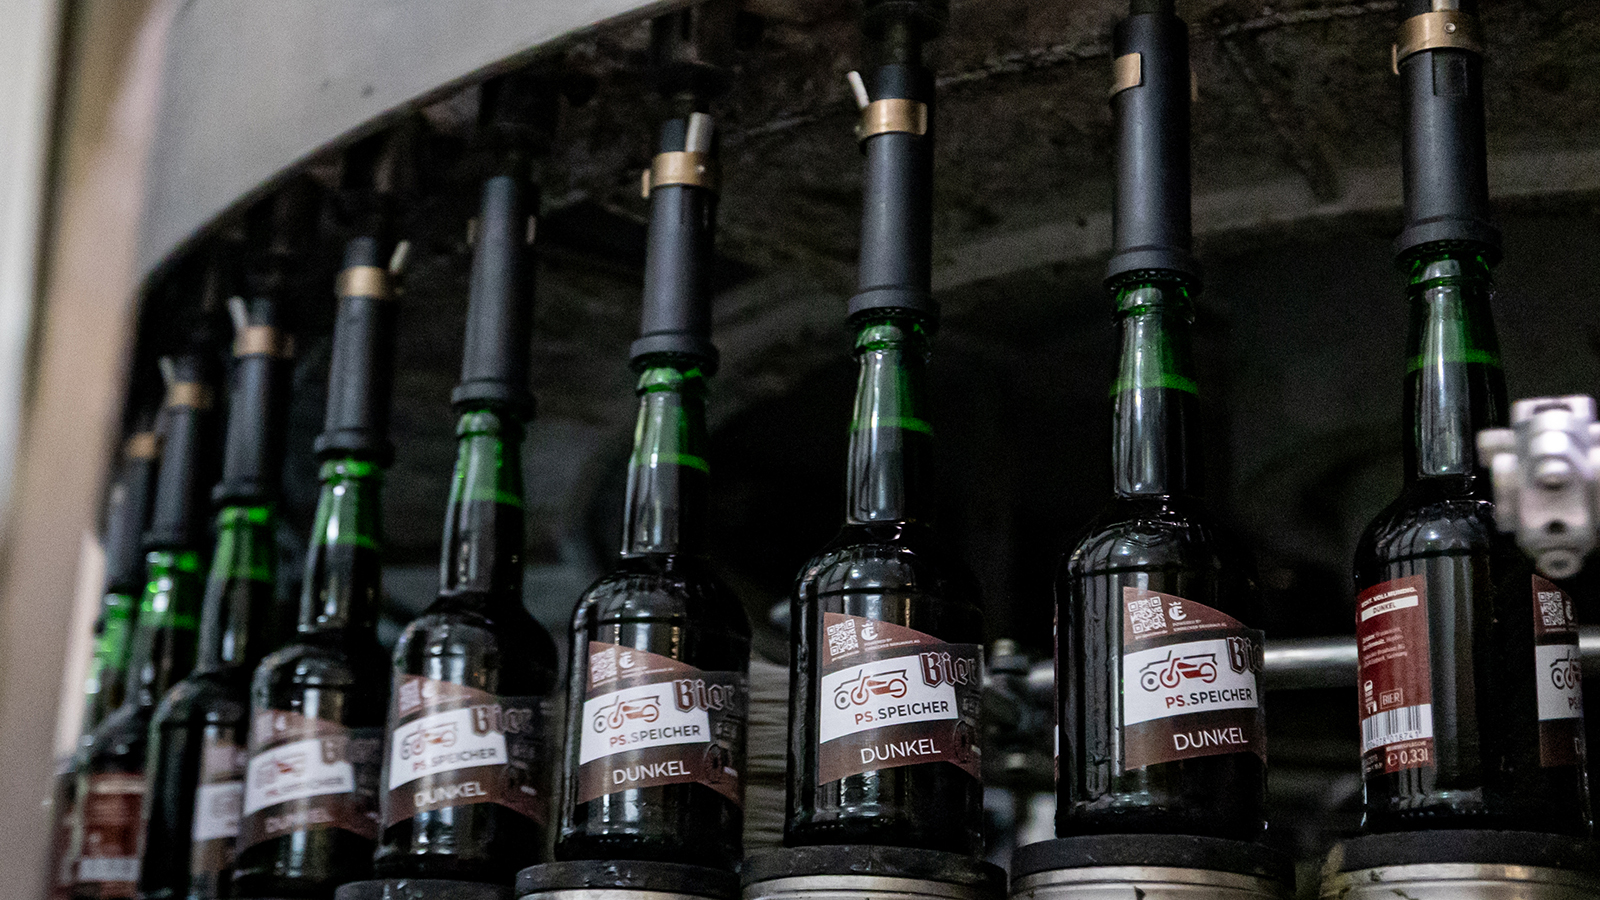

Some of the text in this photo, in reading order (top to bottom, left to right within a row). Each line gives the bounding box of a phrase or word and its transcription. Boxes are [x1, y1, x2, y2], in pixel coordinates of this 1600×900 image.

[1226, 636, 1264, 675] Bie
[919, 651, 976, 688] Bier
[672, 678, 735, 713] Bier
[1165, 688, 1252, 709] PS.SPEICHER
[1382, 692, 1400, 706] BIER
[855, 701, 949, 725] PS.SPEICHER
[609, 724, 701, 747] PS.SPEICHER
[1173, 727, 1248, 751] DUNKEL
[860, 738, 941, 764] DUNKEL
[612, 760, 691, 785] DUNKEL
[413, 781, 488, 808] DUNKEL
